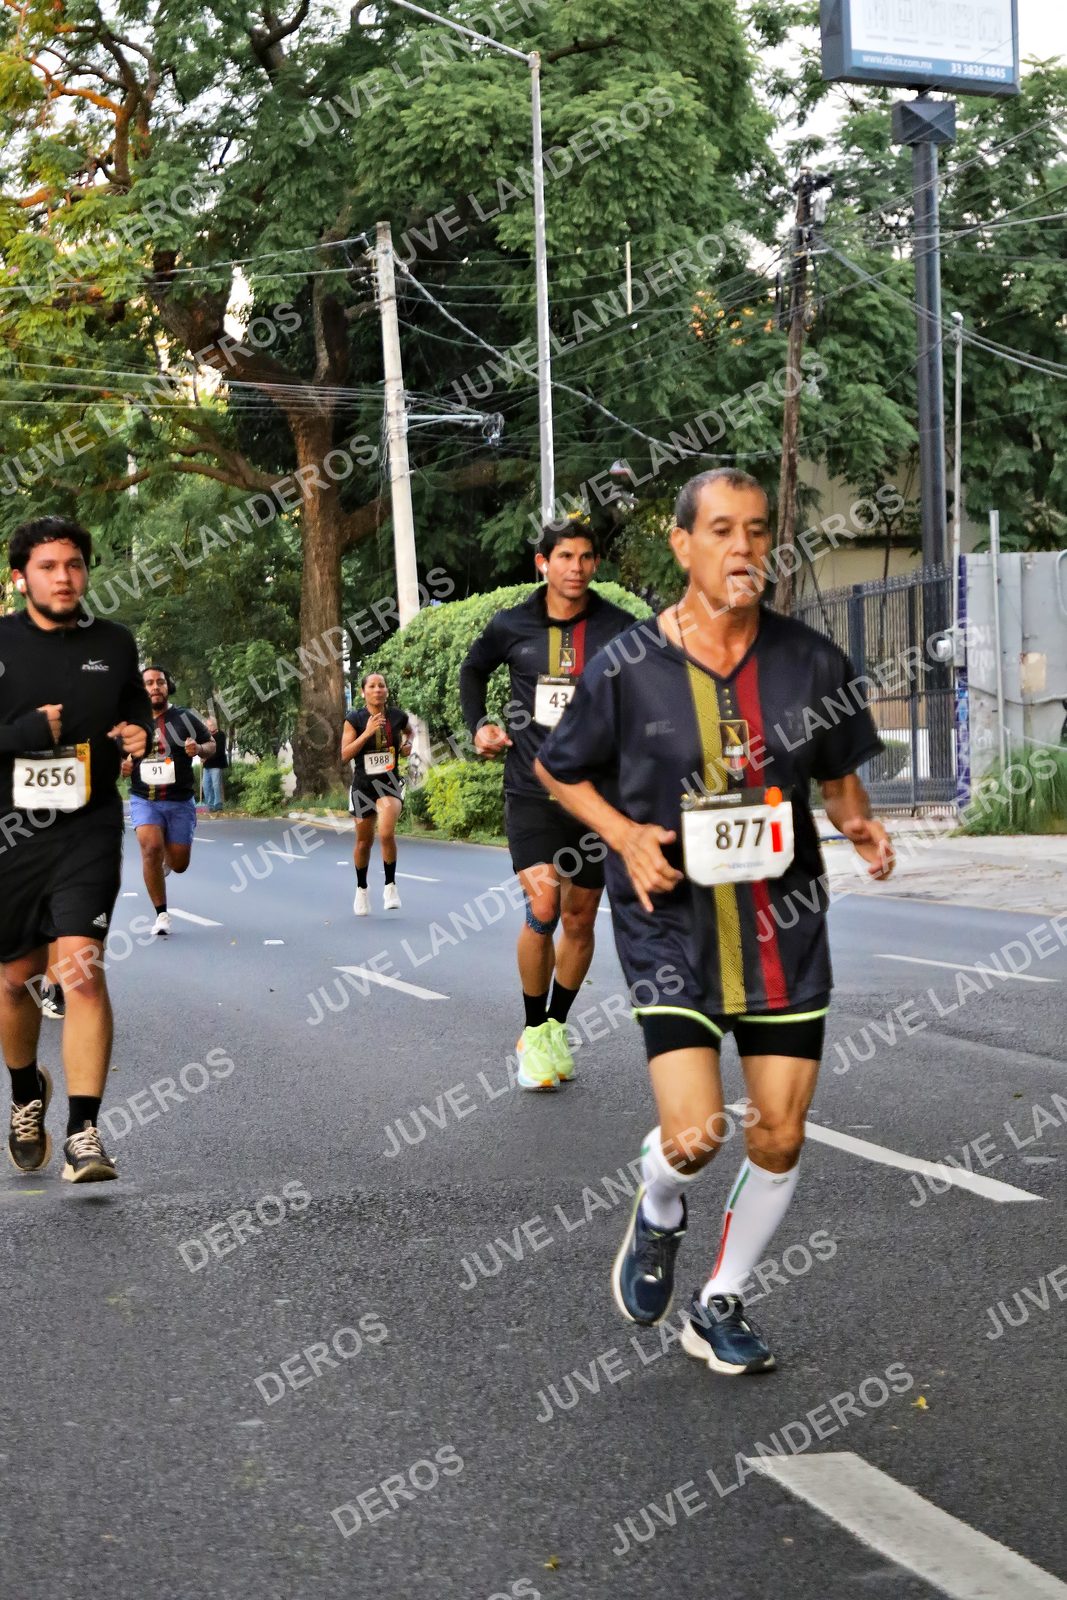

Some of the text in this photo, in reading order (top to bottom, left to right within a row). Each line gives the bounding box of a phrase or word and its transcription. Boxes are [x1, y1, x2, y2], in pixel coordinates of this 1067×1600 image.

[369, 755, 390, 765] 1988
[24, 766, 76, 787] 2656
[152, 767, 162, 775] 91
[716, 818, 766, 850] 877
